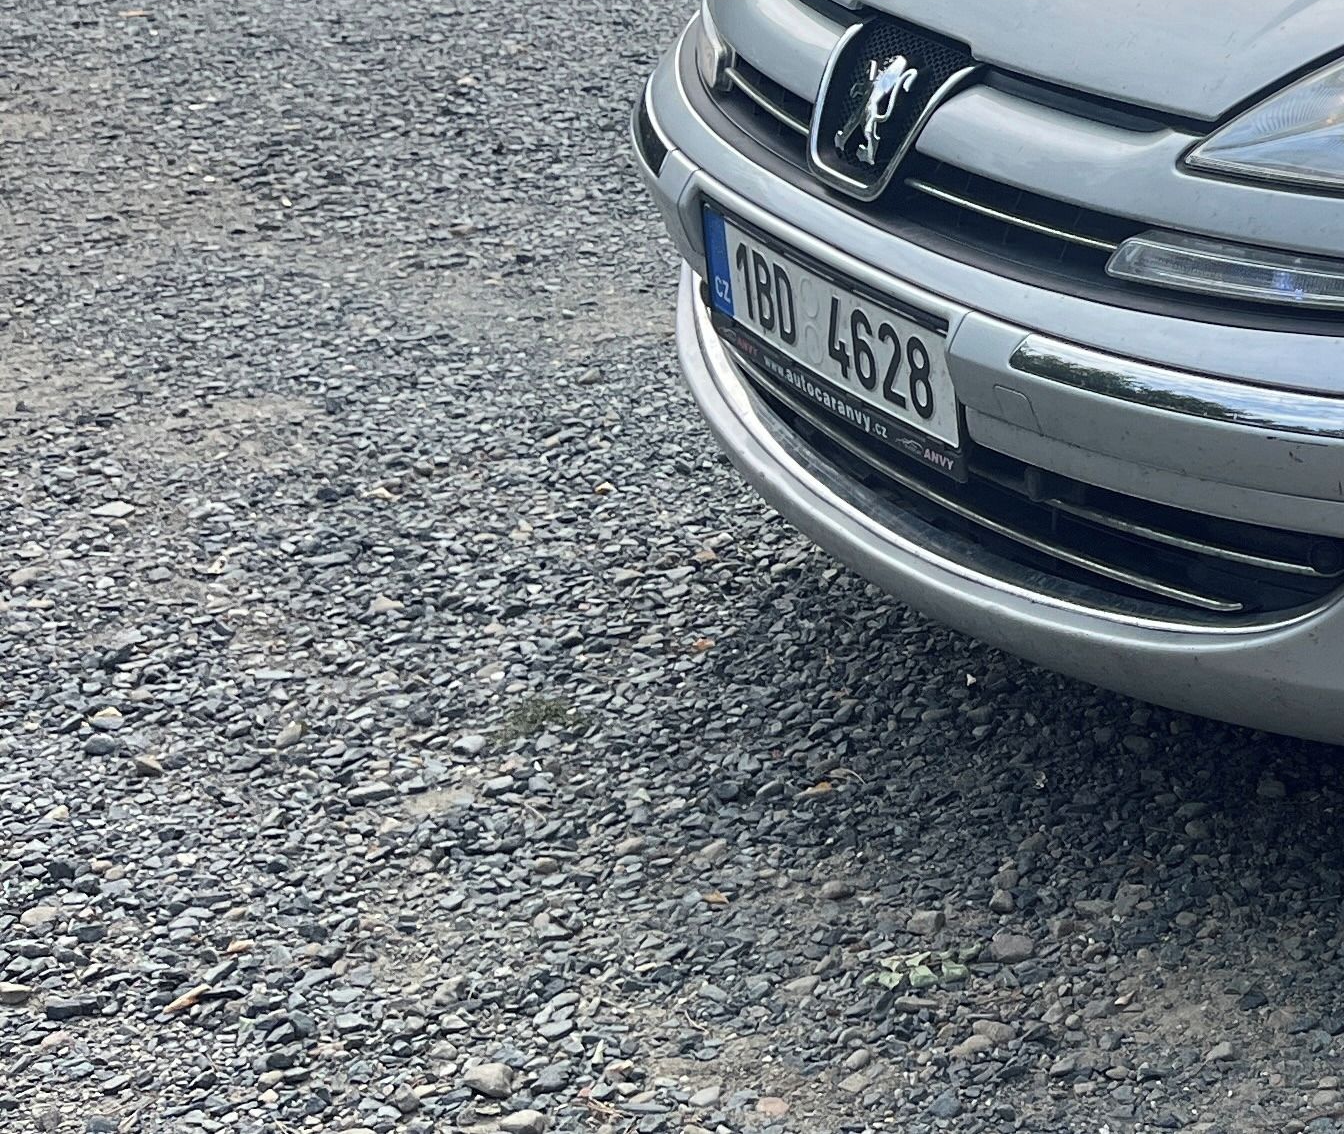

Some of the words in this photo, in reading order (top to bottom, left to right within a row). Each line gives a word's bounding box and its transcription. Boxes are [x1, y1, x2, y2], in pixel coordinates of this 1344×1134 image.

[714, 274, 732, 304] CZ
[736, 242, 796, 346] 1BD
[828, 296, 934, 418] 4628
[763, 355, 889, 439] www.autocaranvy.cz
[923, 448, 954, 471] ANVY
